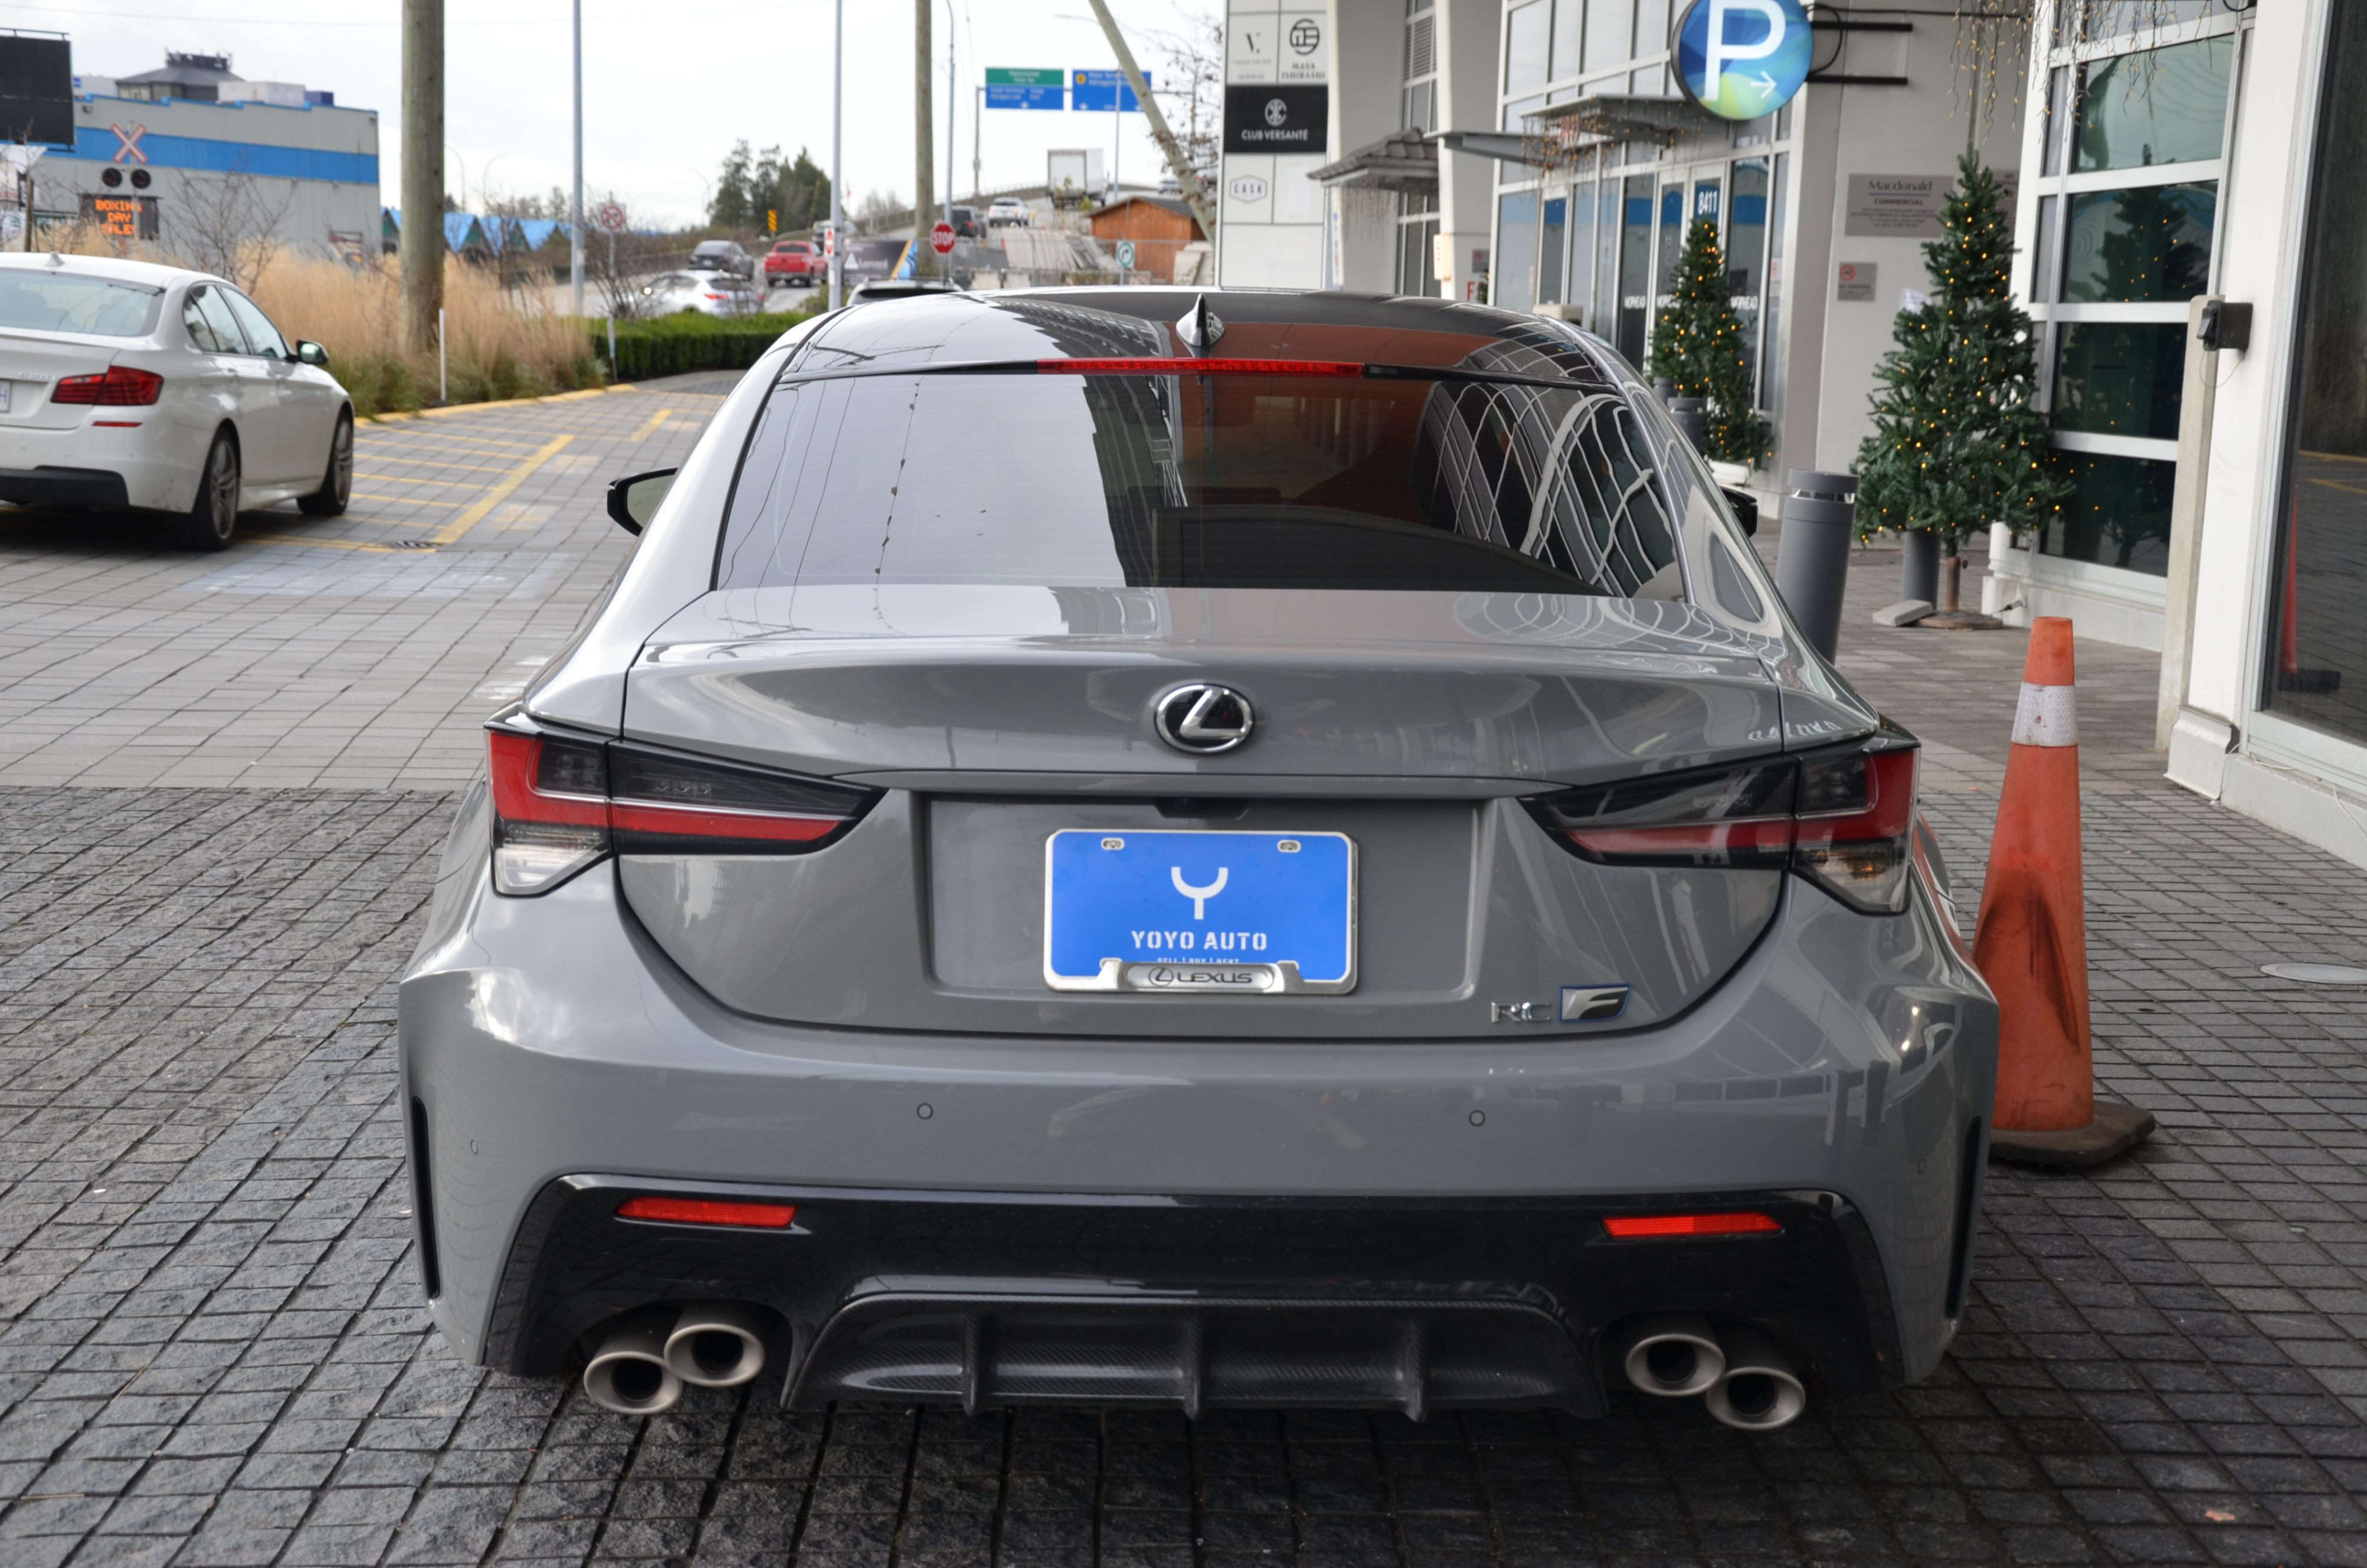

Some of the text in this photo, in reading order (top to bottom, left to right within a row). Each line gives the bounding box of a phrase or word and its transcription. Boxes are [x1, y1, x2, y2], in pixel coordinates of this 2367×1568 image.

[1705, 0, 1786, 101] P
[1241, 127, 1308, 141] CLUB VERSANTÉ
[1234, 183, 1262, 194] CASK
[1868, 180, 1932, 191] Macdonald
[1698, 190, 1718, 215] 8411
[107, 212, 131, 222] DAY
[932, 231, 955, 245] STOP
[1131, 931, 1267, 951] YOYO AUTO
[1177, 972, 1252, 983] LEXUS
[1491, 1002, 1550, 1022] RC
